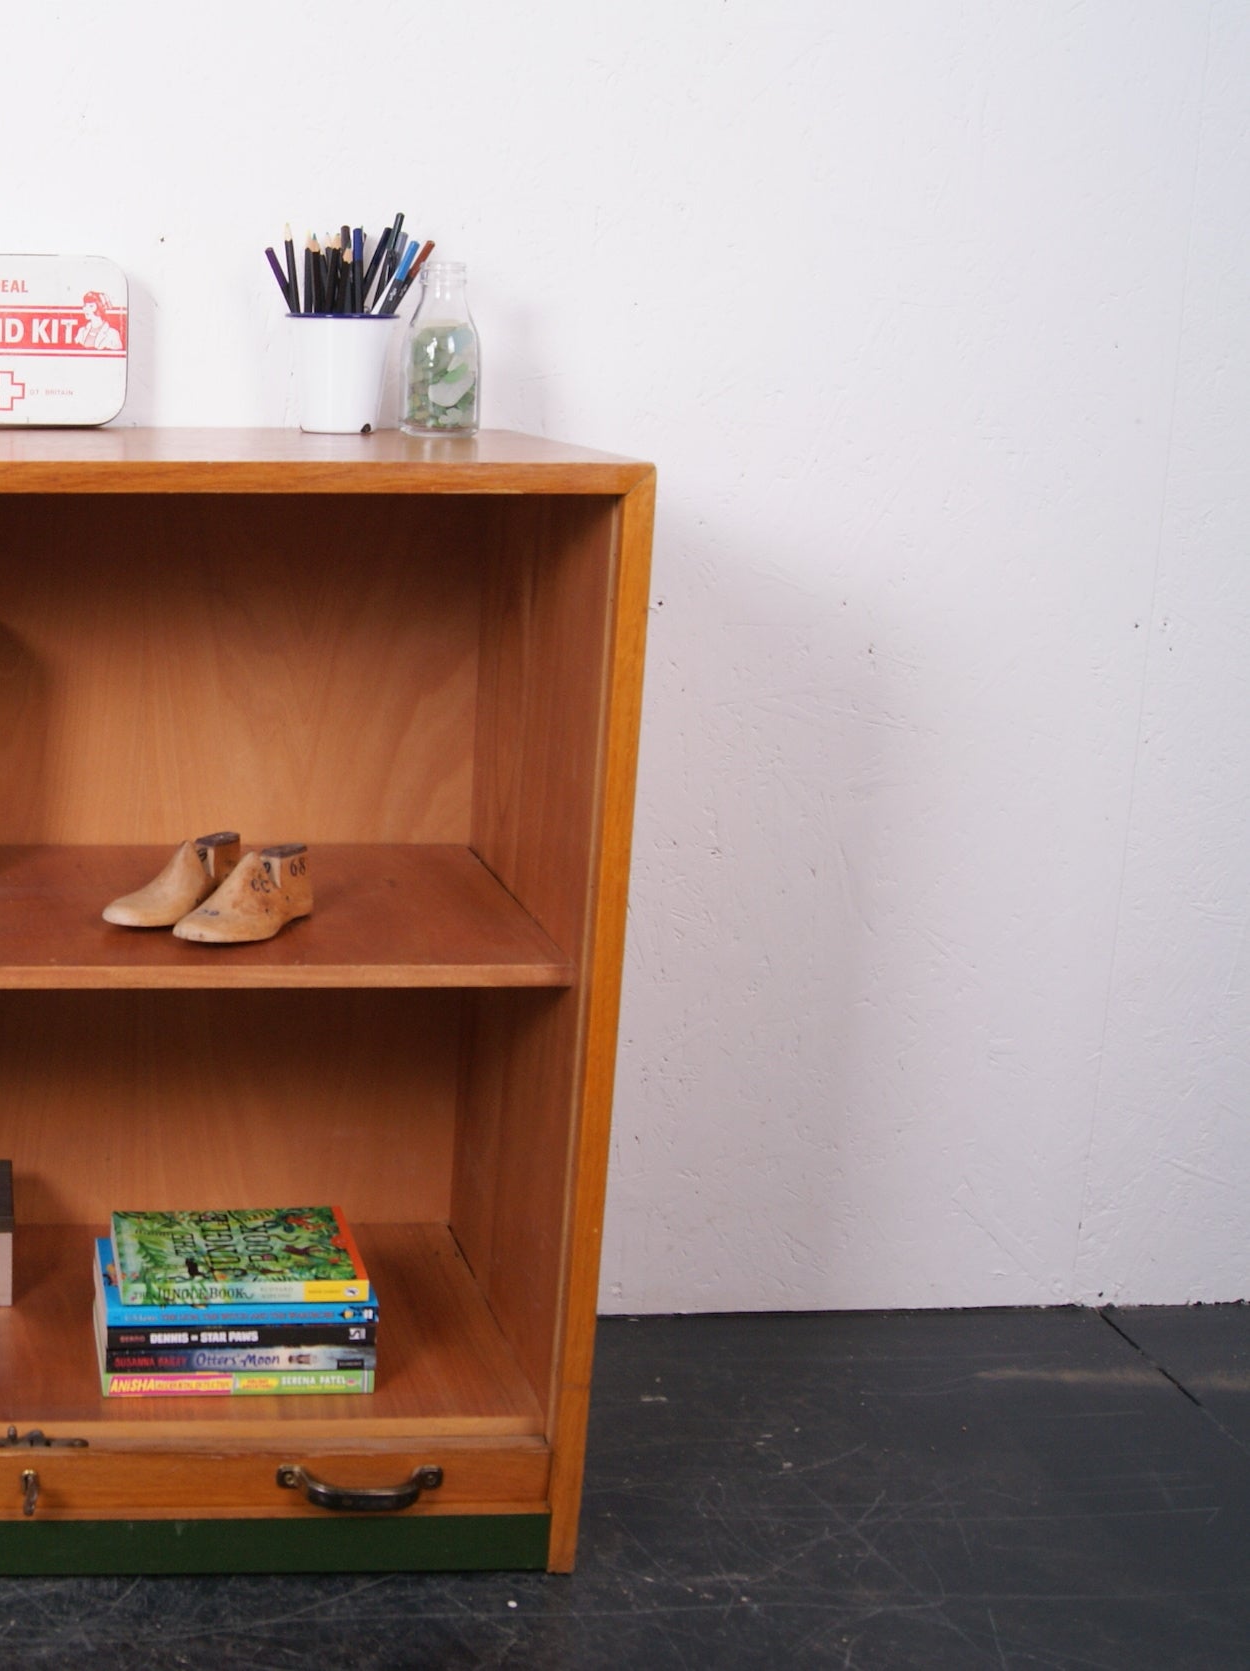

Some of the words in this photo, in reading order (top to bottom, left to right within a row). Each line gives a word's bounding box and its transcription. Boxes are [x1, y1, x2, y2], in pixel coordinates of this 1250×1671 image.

[31, 318, 78, 344] KIT
[171, 1233, 197, 1256] THE
[200, 1214, 248, 1278] JUNGLE
[239, 1220, 279, 1263] BOOK
[209, 1286, 244, 1300] BOOK
[150, 1331, 189, 1345] DENNIS
[200, 1331, 227, 1343] STAR
[228, 1331, 259, 1343] PAWS
[195, 1352, 240, 1367] Otters'
[240, 1353, 280, 1367] Moon
[281, 1376, 316, 1385] SERENA
[320, 1375, 346, 1384] PATEL
